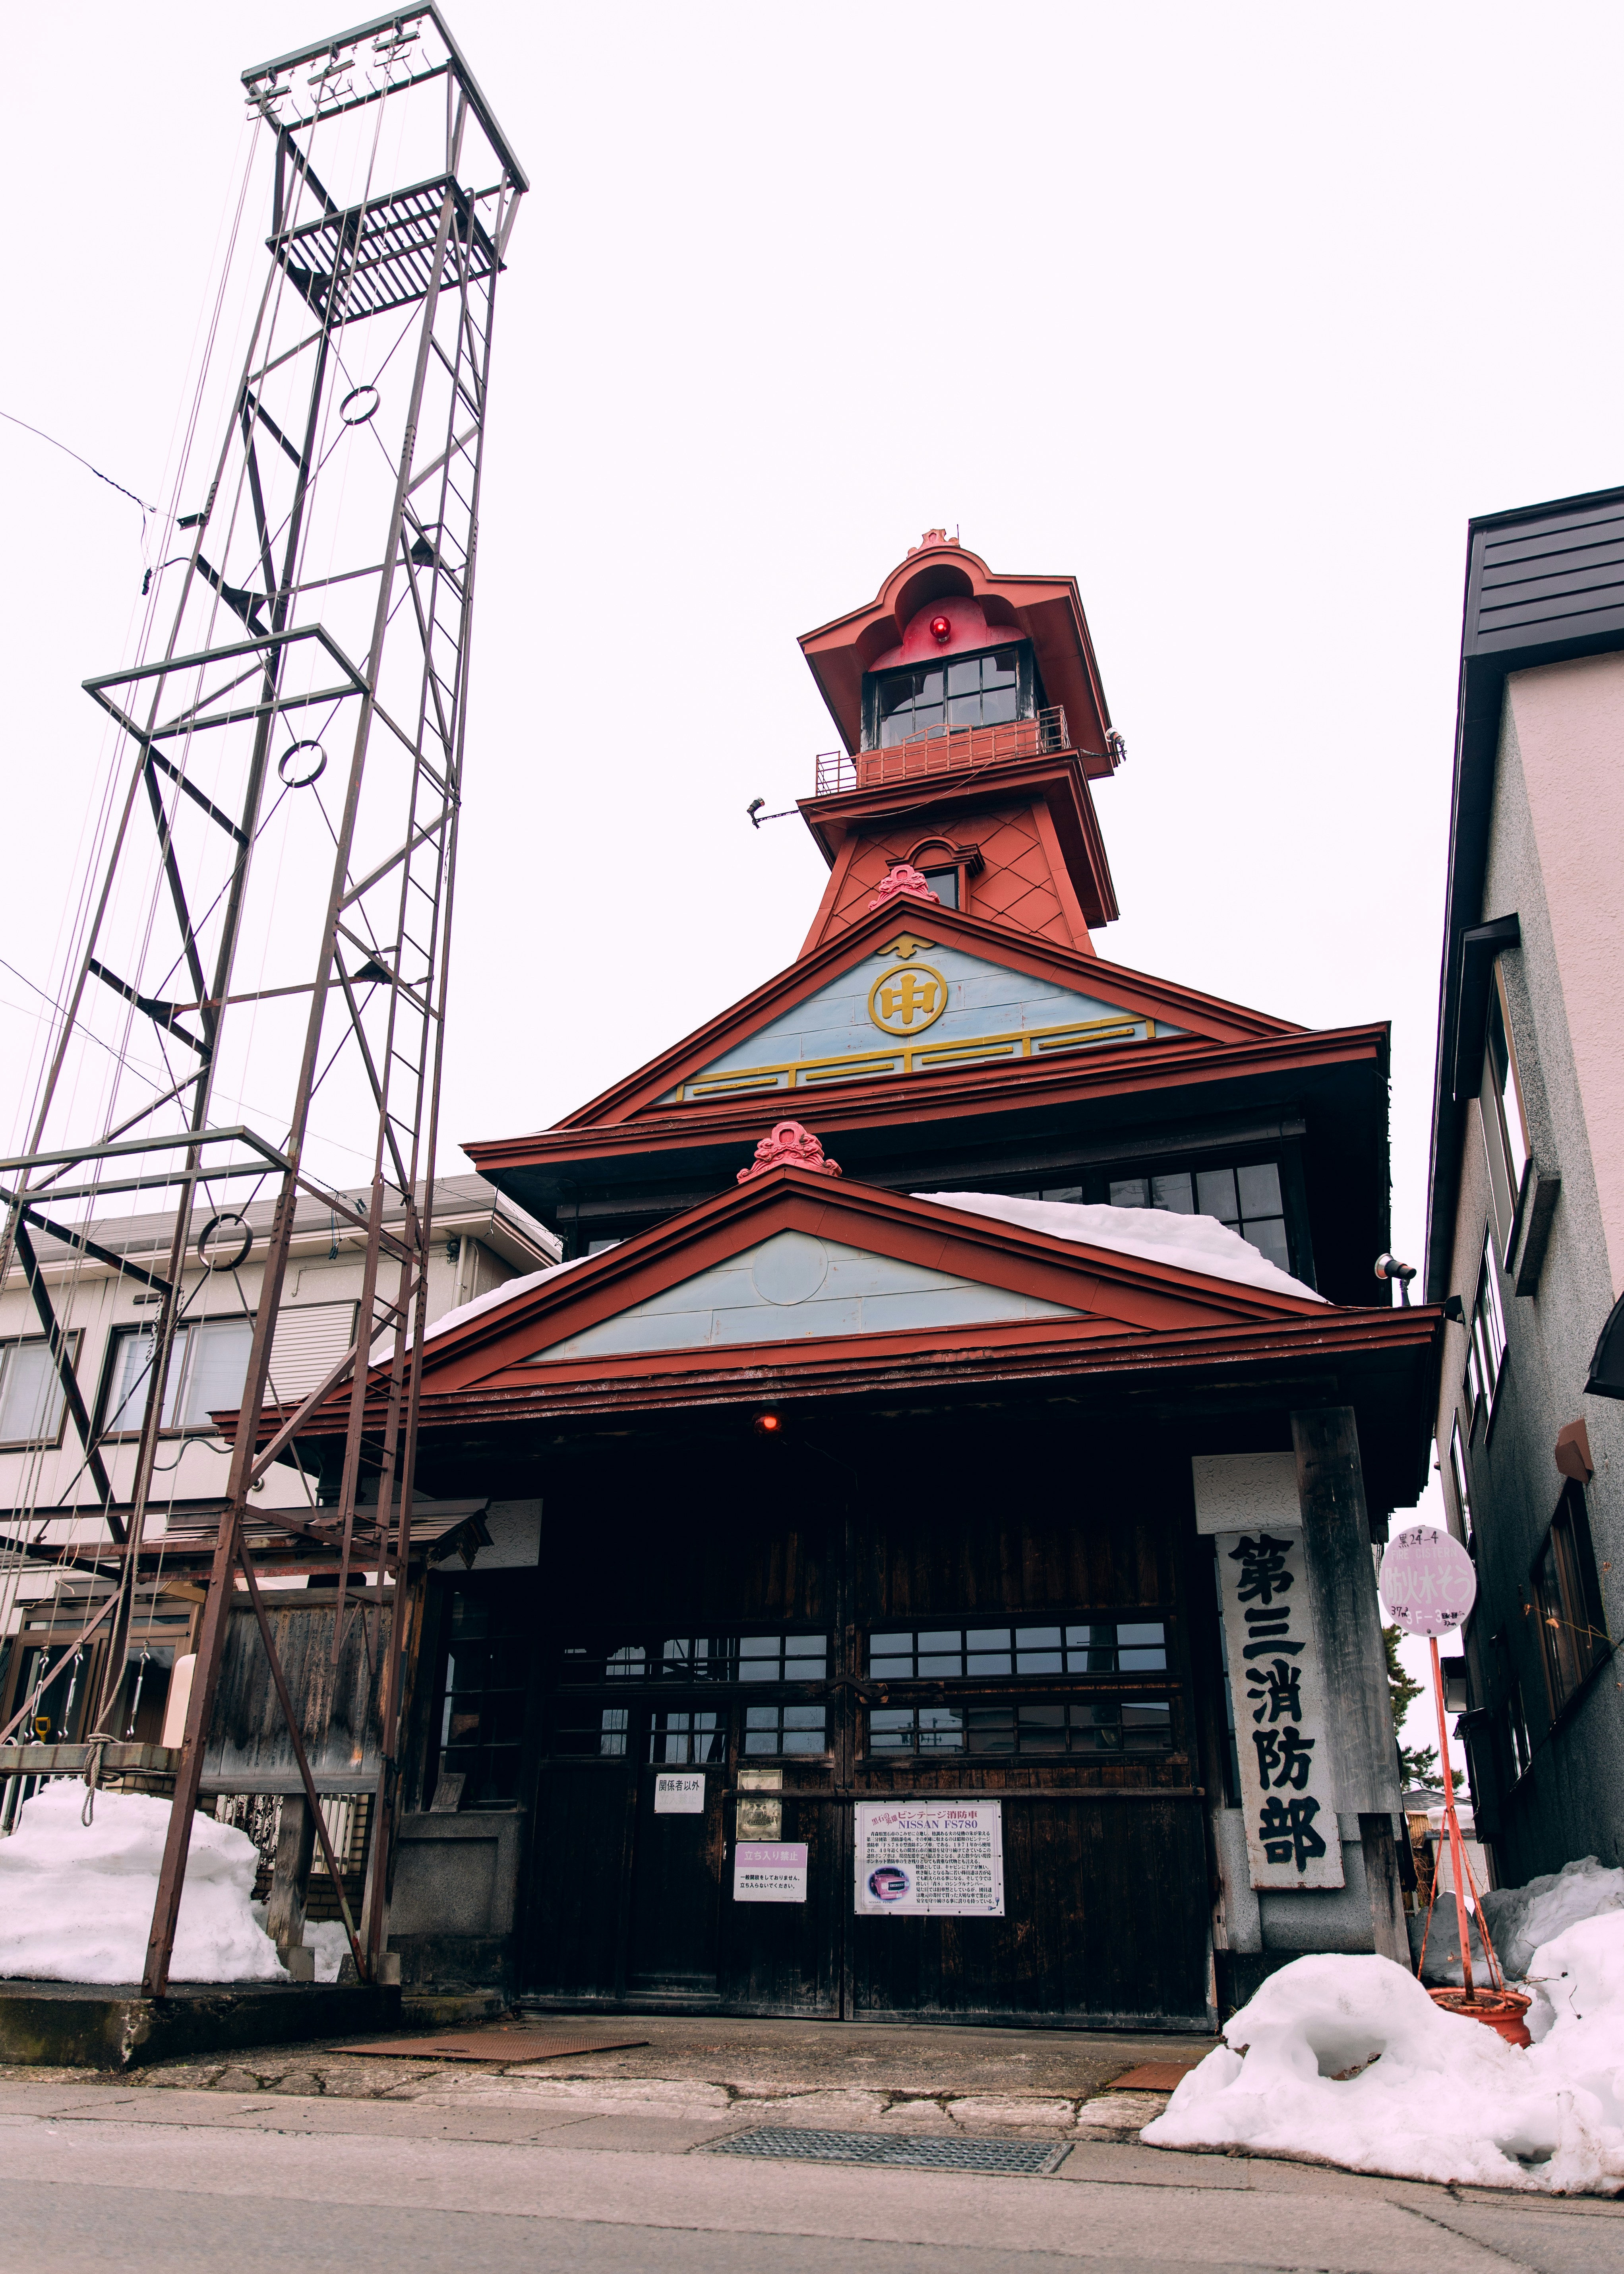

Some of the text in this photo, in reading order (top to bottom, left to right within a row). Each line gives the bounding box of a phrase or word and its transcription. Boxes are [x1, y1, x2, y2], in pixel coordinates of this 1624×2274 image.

[1391, 1546, 1457, 1560] FIRE CISTERN
[1384, 1564, 1471, 1605] 防火水そう
[1229, 1533, 1327, 1873] 第三消防部
[659, 1780, 699, 1792] 関係者以外
[660, 1793, 697, 1805] 立入禁止
[871, 1812, 890, 1826] 黒石の
[886, 1814, 898, 1826] 英雄
[898, 1811, 977, 1819] ビンテージ消防車
[898, 1820, 978, 1828] NISSAN FS780
[744, 1850, 798, 1861] 立ち入り禁止
